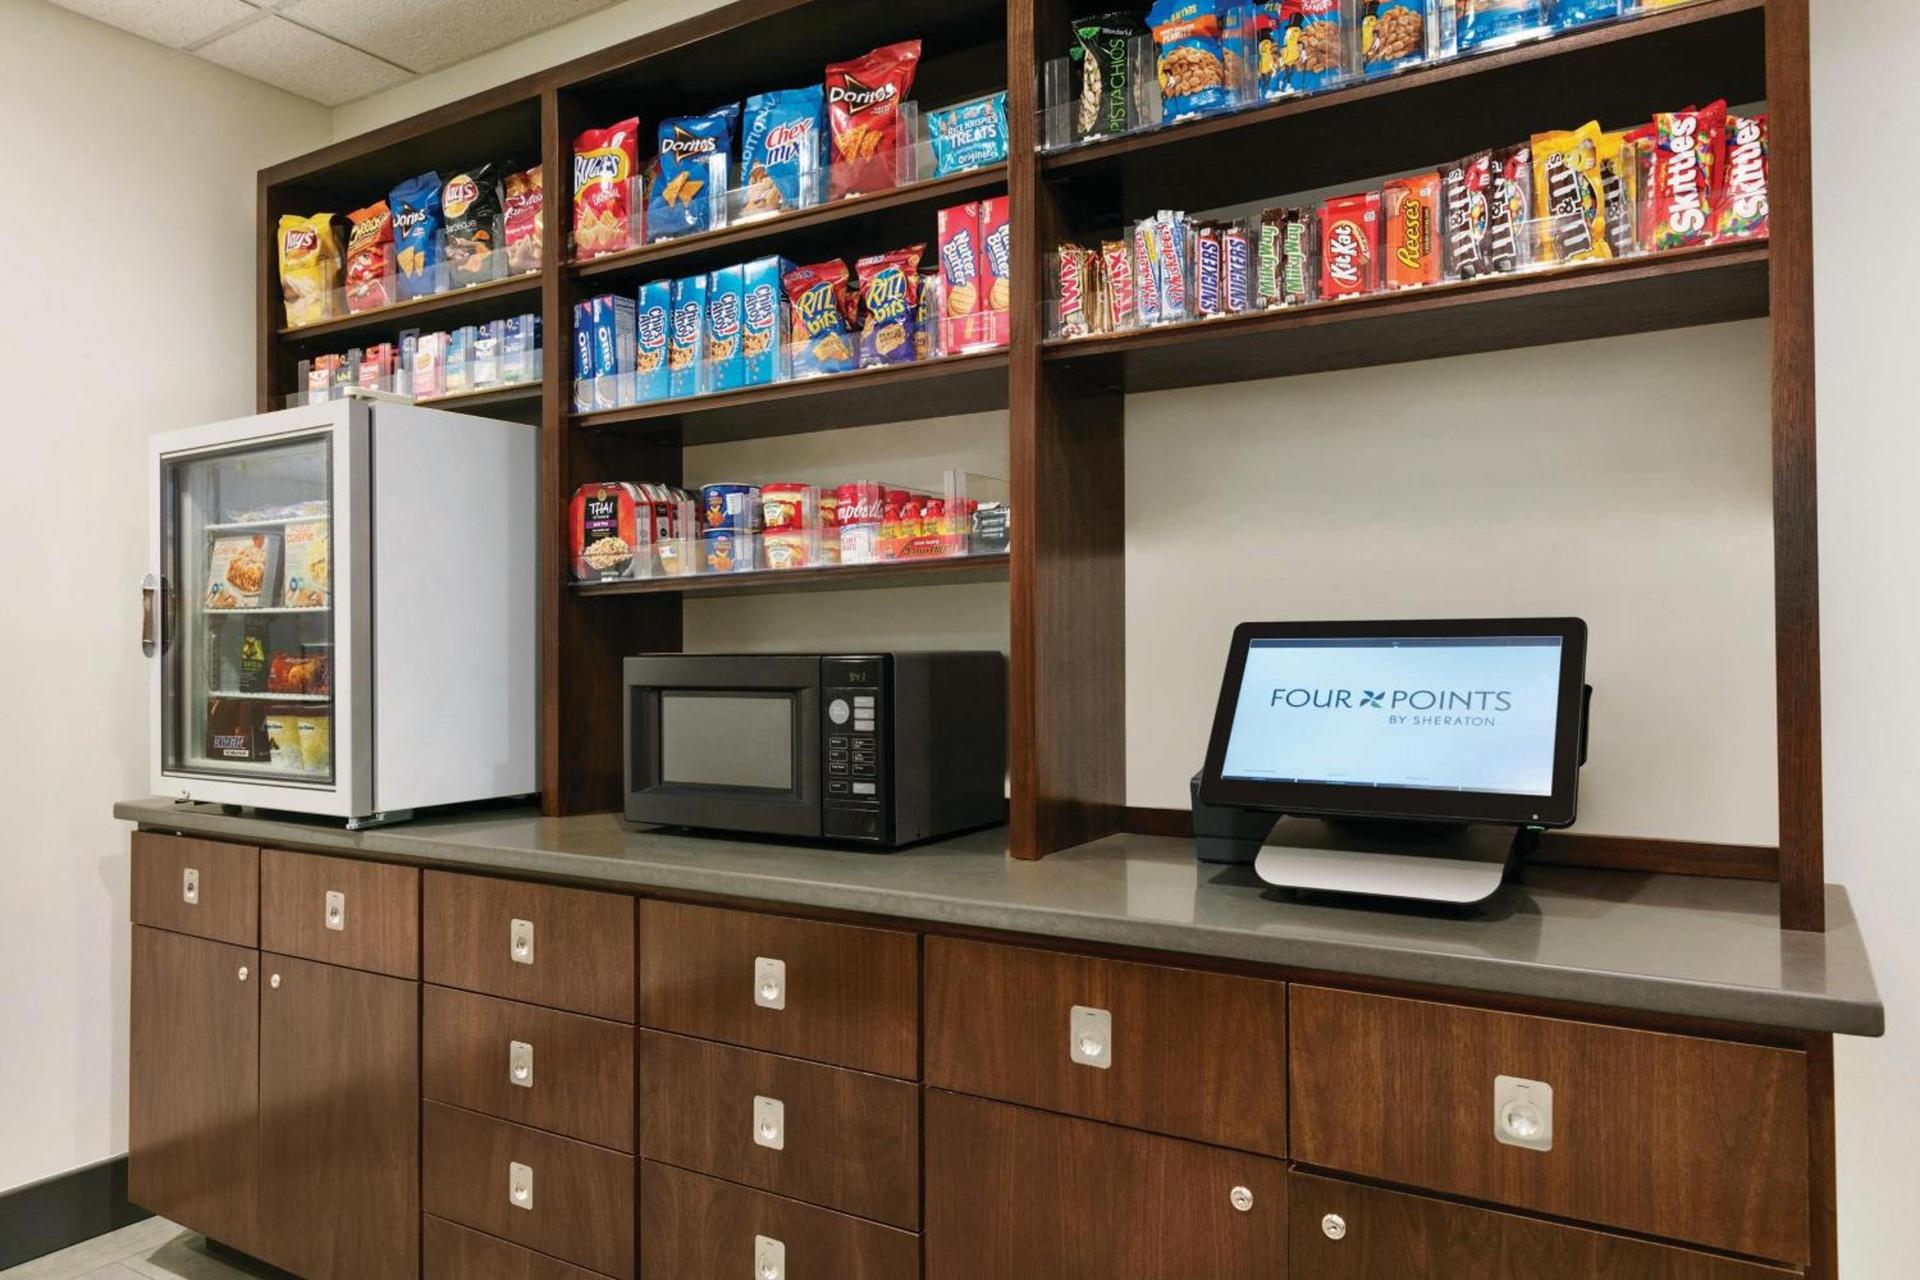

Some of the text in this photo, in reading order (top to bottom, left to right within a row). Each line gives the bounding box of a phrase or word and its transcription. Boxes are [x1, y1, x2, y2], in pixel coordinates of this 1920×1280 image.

[830, 83, 897, 104] Doritos
[1110, 39, 1125, 132] PISTACHIOS
[661, 136, 716, 154] Doritos
[767, 118, 813, 149] Chex
[951, 124, 997, 149] TREATS
[943, 241, 966, 286] Butter
[953, 229, 976, 277] Nutter
[867, 273, 904, 309] RITZ
[1200, 242, 1219, 314] SNICKERS
[1228, 238, 1248, 312] SNICKERS
[721, 292, 738, 328] Chips
[745, 293, 774, 328] Ahoy!
[755, 285, 775, 321] Chips
[798, 285, 834, 317] RITZ
[873, 299, 906, 322] bits
[640, 314, 665, 347] Ahoy!
[648, 306, 665, 342] Chips
[676, 310, 698, 343] Ahoy!
[685, 301, 701, 338] Chips
[712, 301, 738, 335] Ahoy!
[807, 311, 838, 335] bits
[588, 502, 614, 515] THAI
[1270, 688, 1512, 713] FOUR POINTS
[1389, 715, 1497, 727] BY SHERATON
